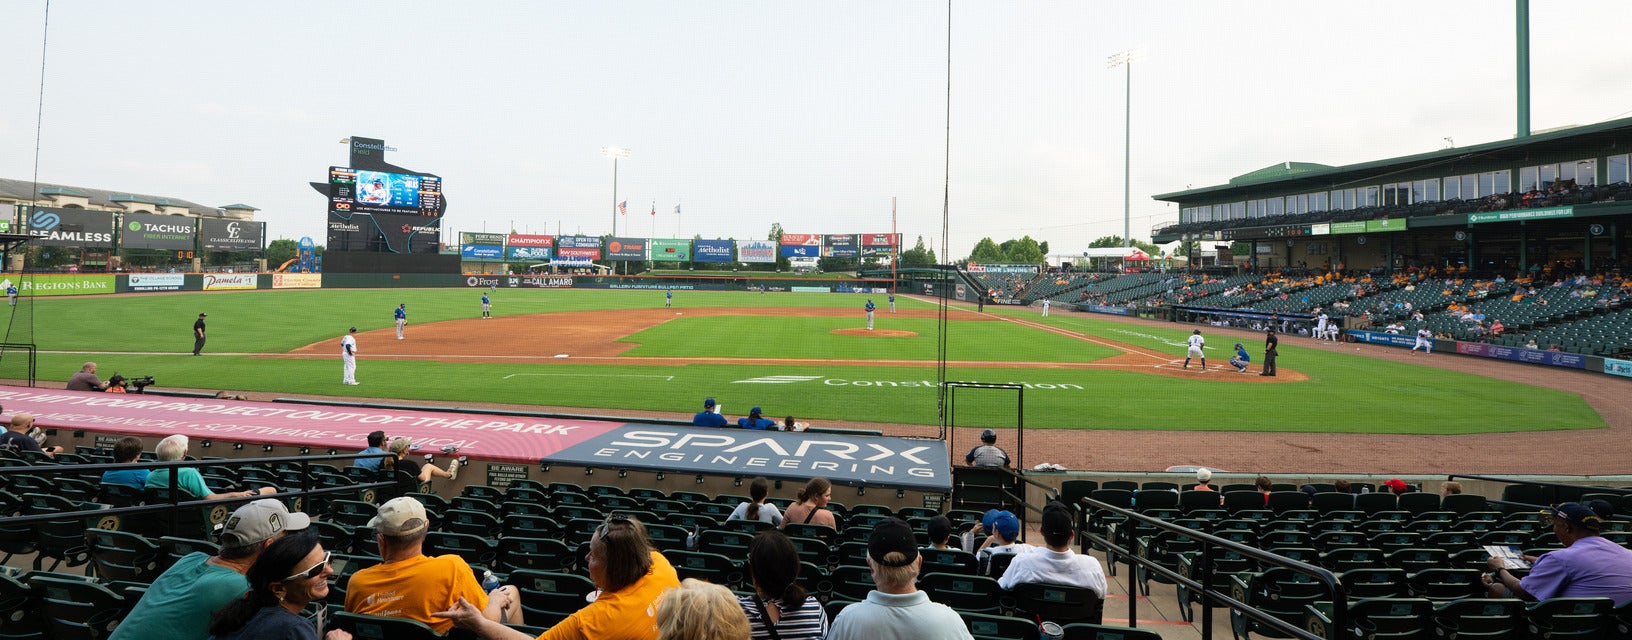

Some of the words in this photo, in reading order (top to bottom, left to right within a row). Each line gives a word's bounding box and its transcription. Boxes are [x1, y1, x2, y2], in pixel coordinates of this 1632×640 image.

[353, 141, 398, 152] Constellation
[144, 223, 191, 235] TACHUS
[330, 222, 359, 231] Methodist
[23, 280, 81, 291] REGIONS
[83, 280, 108, 290] BANK
[204, 275, 242, 289] Pamela
[479, 277, 499, 286] Frost
[531, 278, 548, 286] CALL
[548, 278, 573, 286] AMARO
[16, 393, 84, 404] HIT
[71, 397, 163, 409] YOUR
[148, 402, 279, 417] PROJECT
[285, 408, 369, 422] OUT
[358, 413, 417, 426] OF
[411, 416, 482, 430] THE
[475, 420, 582, 436] PARK
[42, 412, 187, 429] MECHANICAL
[200, 422, 333, 438] SOFTWARE
[610, 430, 932, 464] SPARX
[593, 448, 935, 478] ENGINEERING
